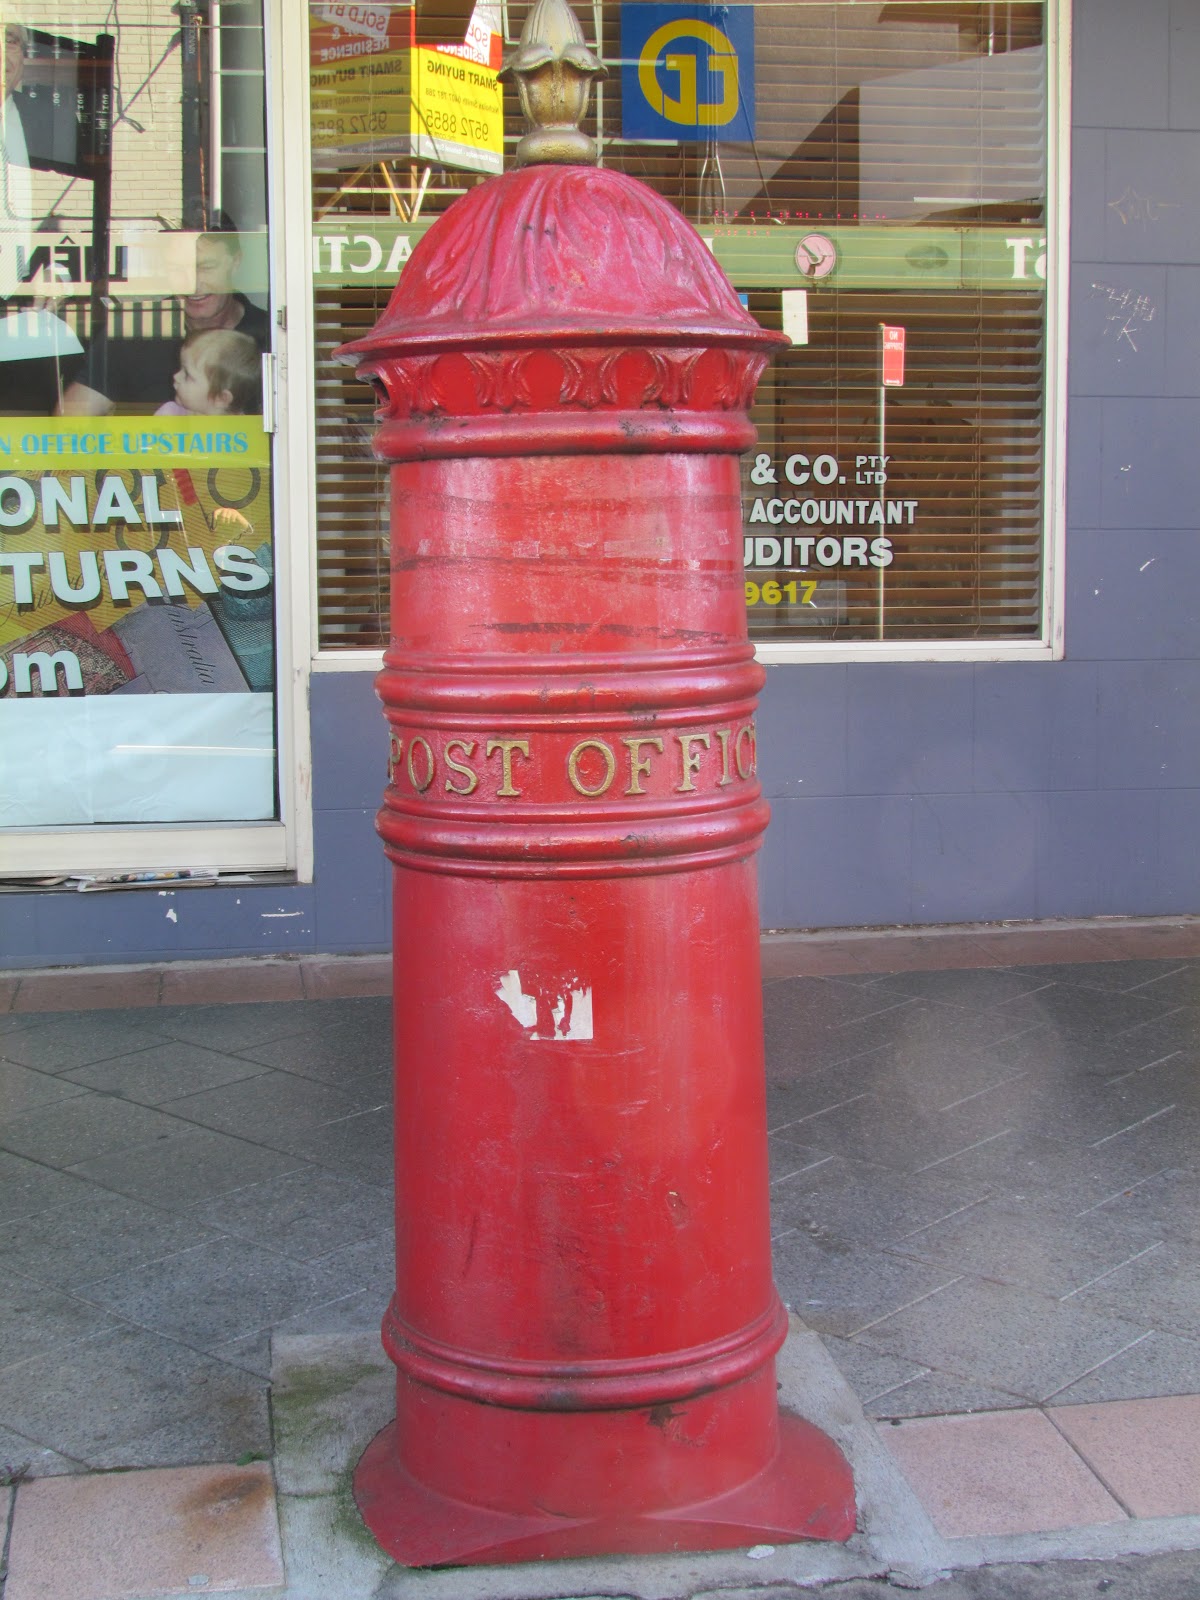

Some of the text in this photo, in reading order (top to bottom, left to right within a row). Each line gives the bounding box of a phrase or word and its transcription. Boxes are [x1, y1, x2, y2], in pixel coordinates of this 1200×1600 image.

[21, 433, 113, 455] OFFICE
[122, 432, 249, 454] UPSTAIRS
[750, 454, 846, 486] & CO.
[856, 456, 890, 468] PTY
[856, 472, 888, 484] LTD
[0, 475, 183, 528] ONAL
[749, 498, 918, 524] ACCOUNTANT
[0, 545, 271, 605] TURNS
[745, 580, 818, 606] 9617
[388, 723, 757, 797] POST OFFIC
